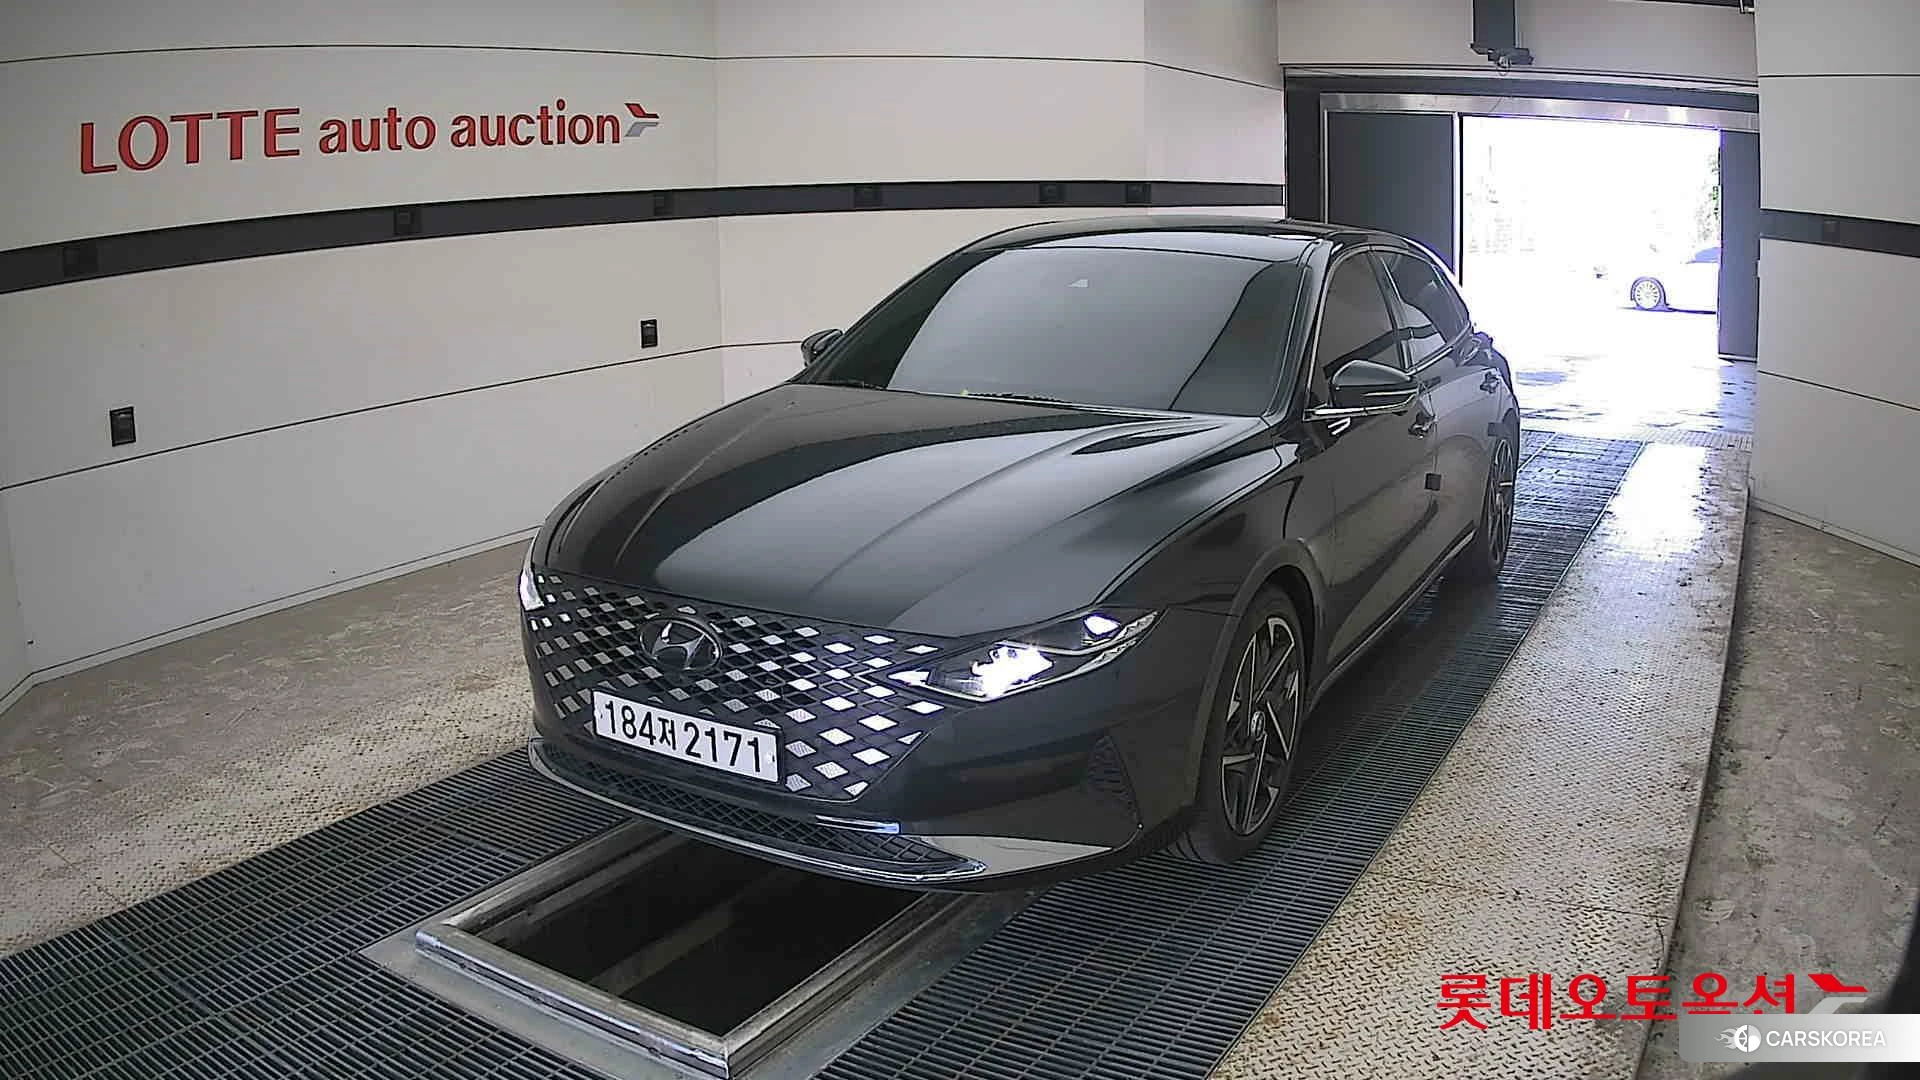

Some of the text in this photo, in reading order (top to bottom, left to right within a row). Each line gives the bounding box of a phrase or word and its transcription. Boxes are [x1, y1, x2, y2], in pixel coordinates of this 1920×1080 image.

[80, 99, 621, 175] LOTTE auto auction
